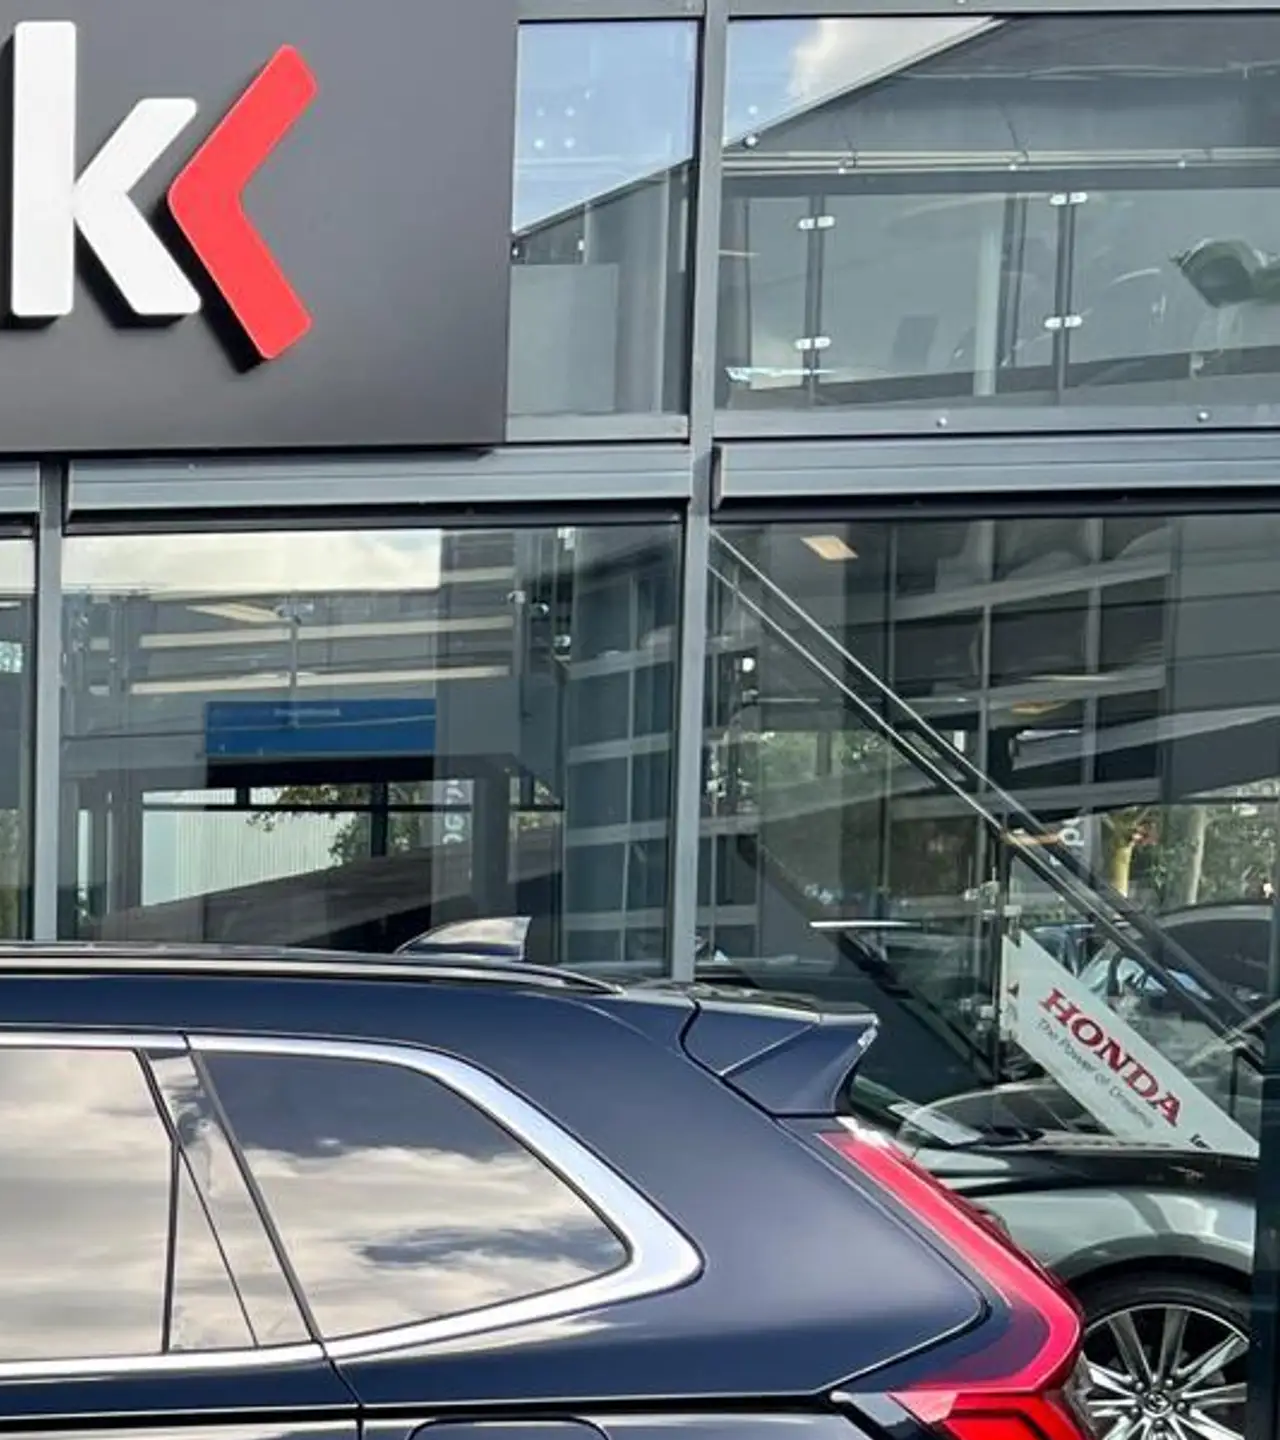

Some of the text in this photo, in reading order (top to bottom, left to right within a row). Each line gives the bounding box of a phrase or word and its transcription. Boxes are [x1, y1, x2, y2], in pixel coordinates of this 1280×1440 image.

[1037, 1018, 1059, 1041] The
[1058, 1038, 1097, 1072] Power
[1109, 1086, 1154, 1129] Dreams
[1038, 987, 1182, 1128] HONDA
